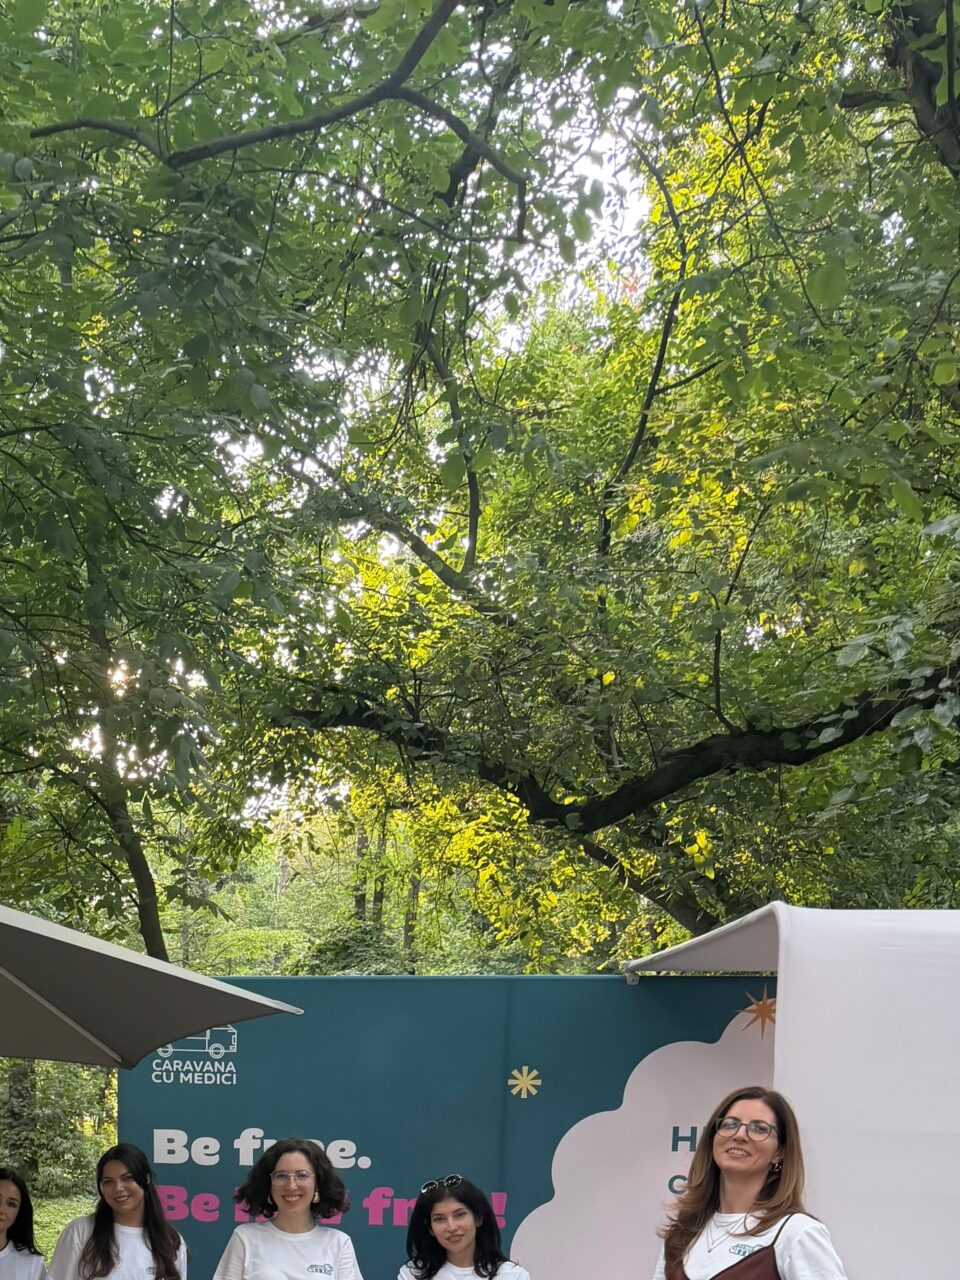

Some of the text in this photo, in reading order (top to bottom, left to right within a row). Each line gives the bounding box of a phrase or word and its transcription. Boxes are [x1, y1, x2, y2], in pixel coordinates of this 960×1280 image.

[151, 1072, 237, 1085] CU MEDICI
[152, 1059, 237, 1073] CARAVANA
[153, 1128, 372, 1169] Be fe.
[155, 1185, 221, 1222] Be
[363, 1187, 508, 1229] fr!
